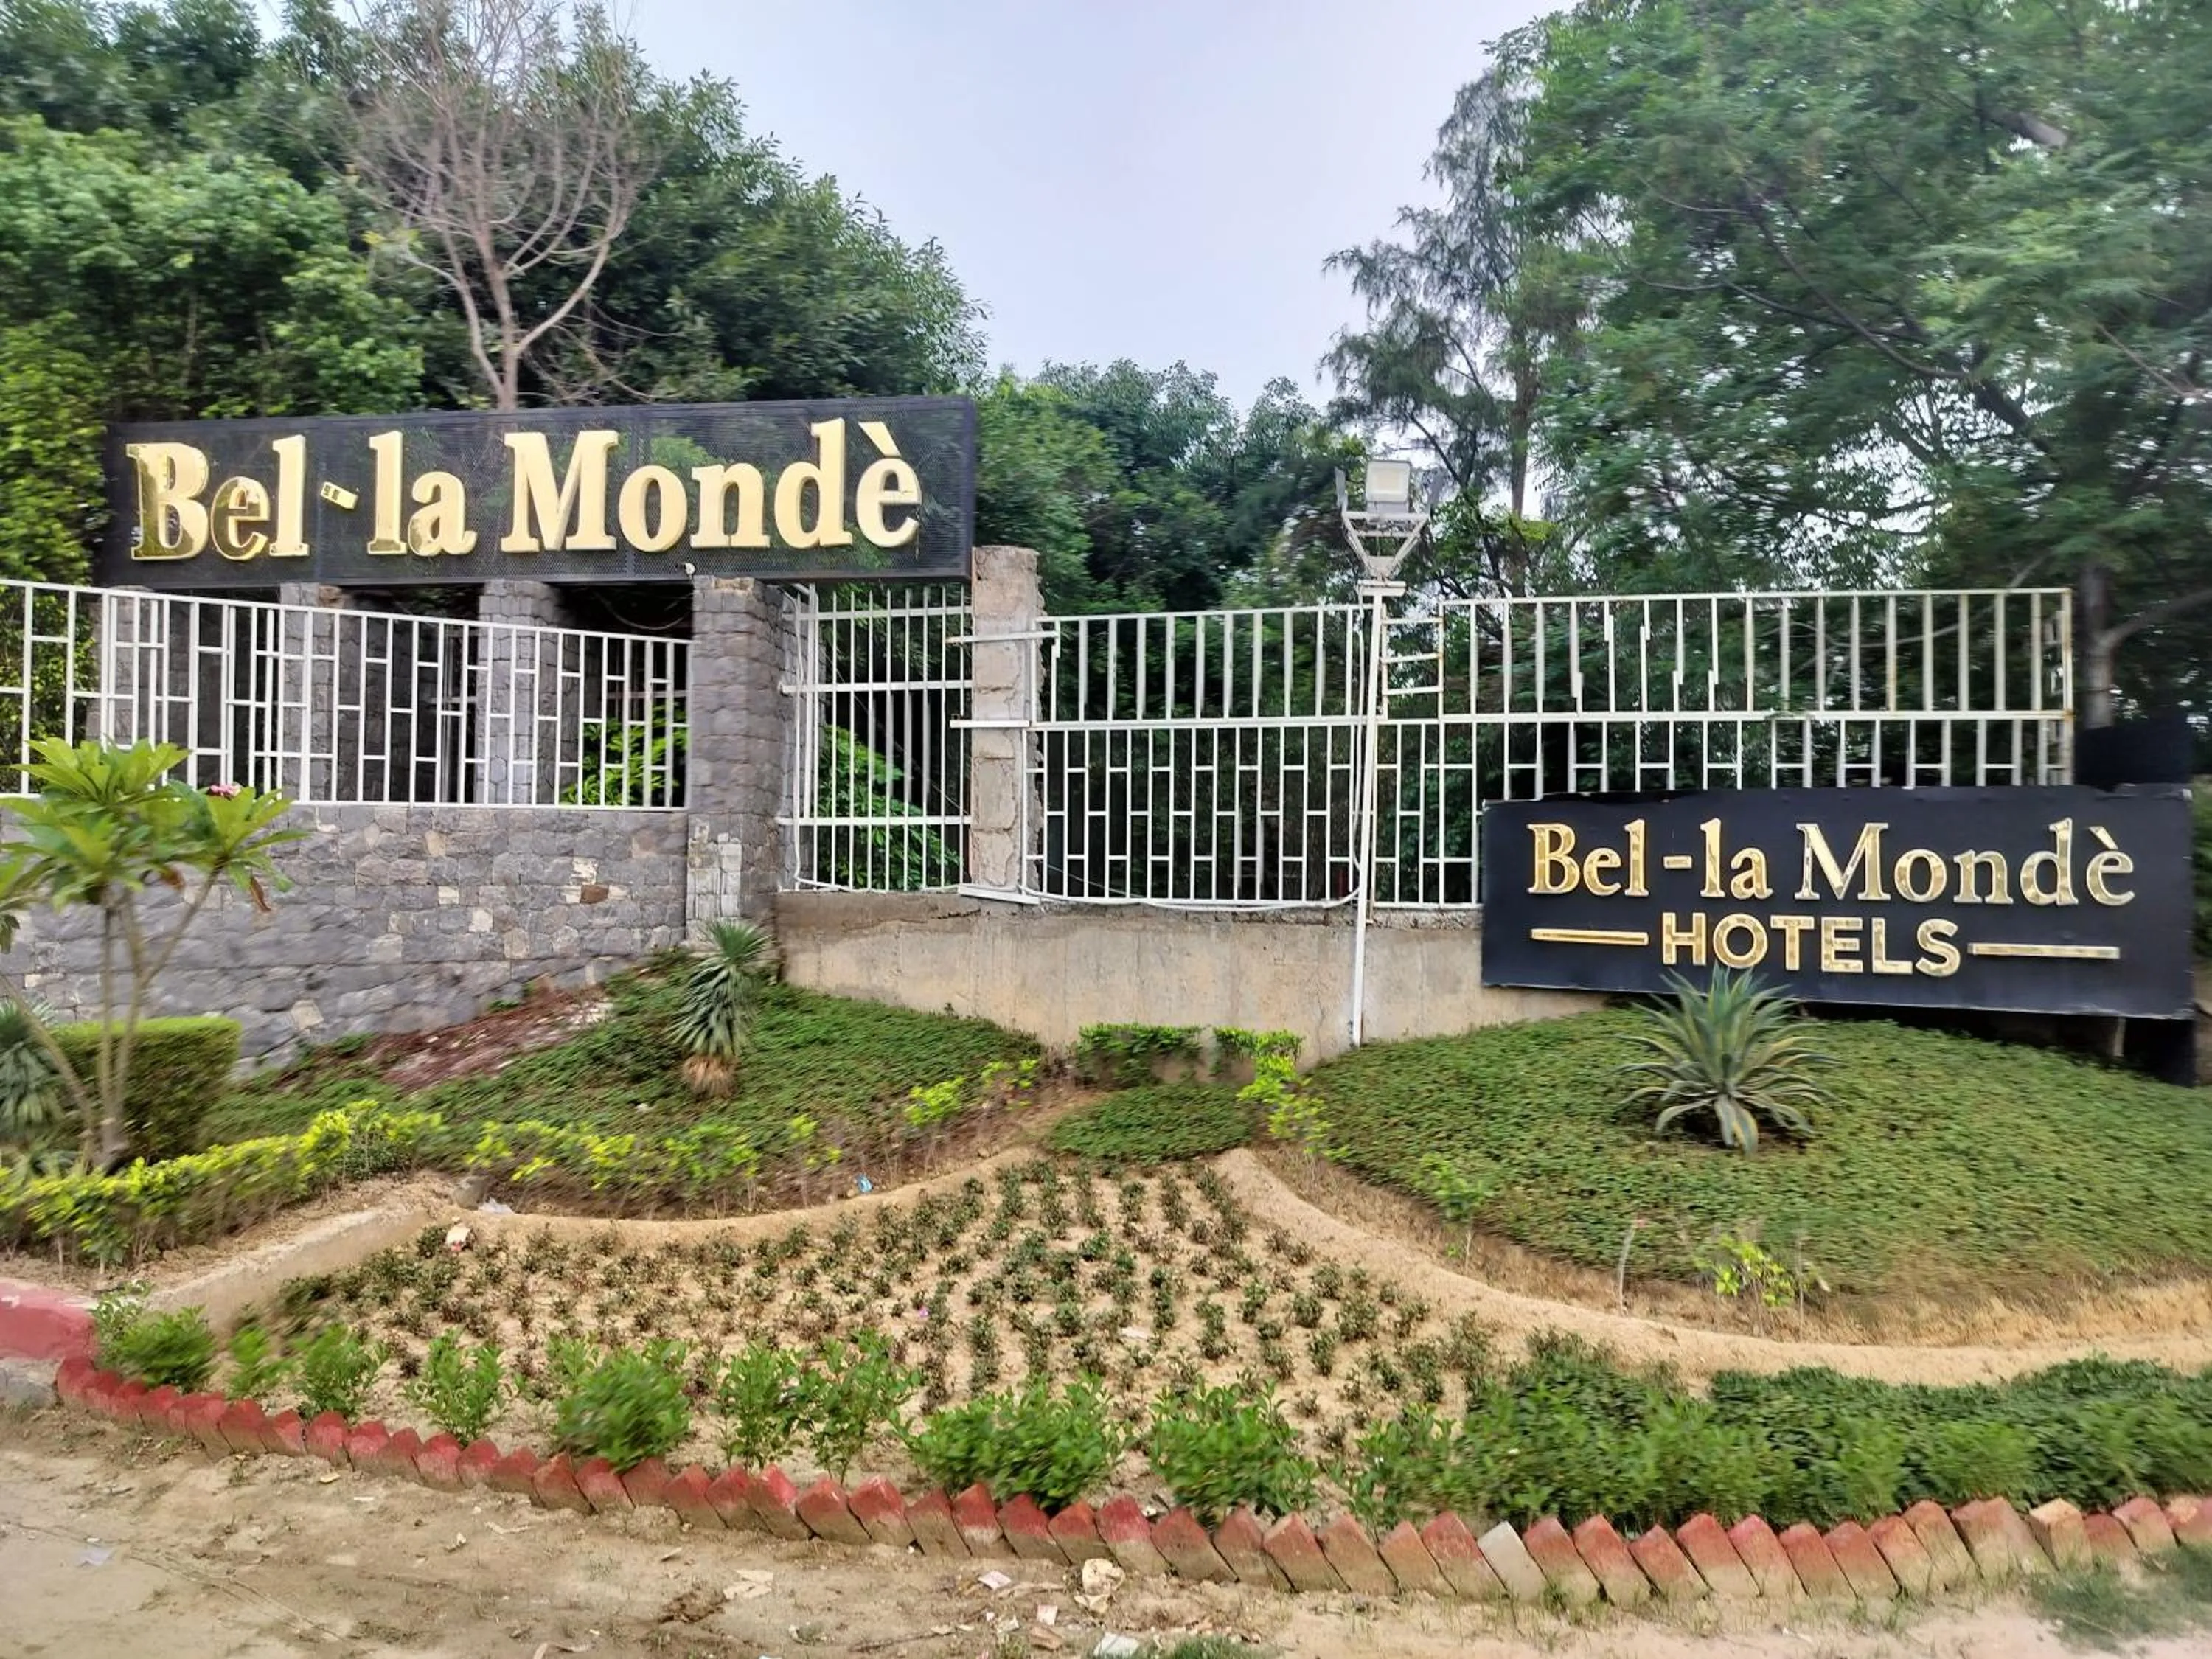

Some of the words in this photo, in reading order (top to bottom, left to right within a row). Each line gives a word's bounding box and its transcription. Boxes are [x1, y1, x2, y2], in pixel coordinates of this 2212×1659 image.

[501, 417, 922, 554] Mondè
[1793, 818, 2135, 906] Mondè
[1660, 911, 1961, 978] HOTELS
